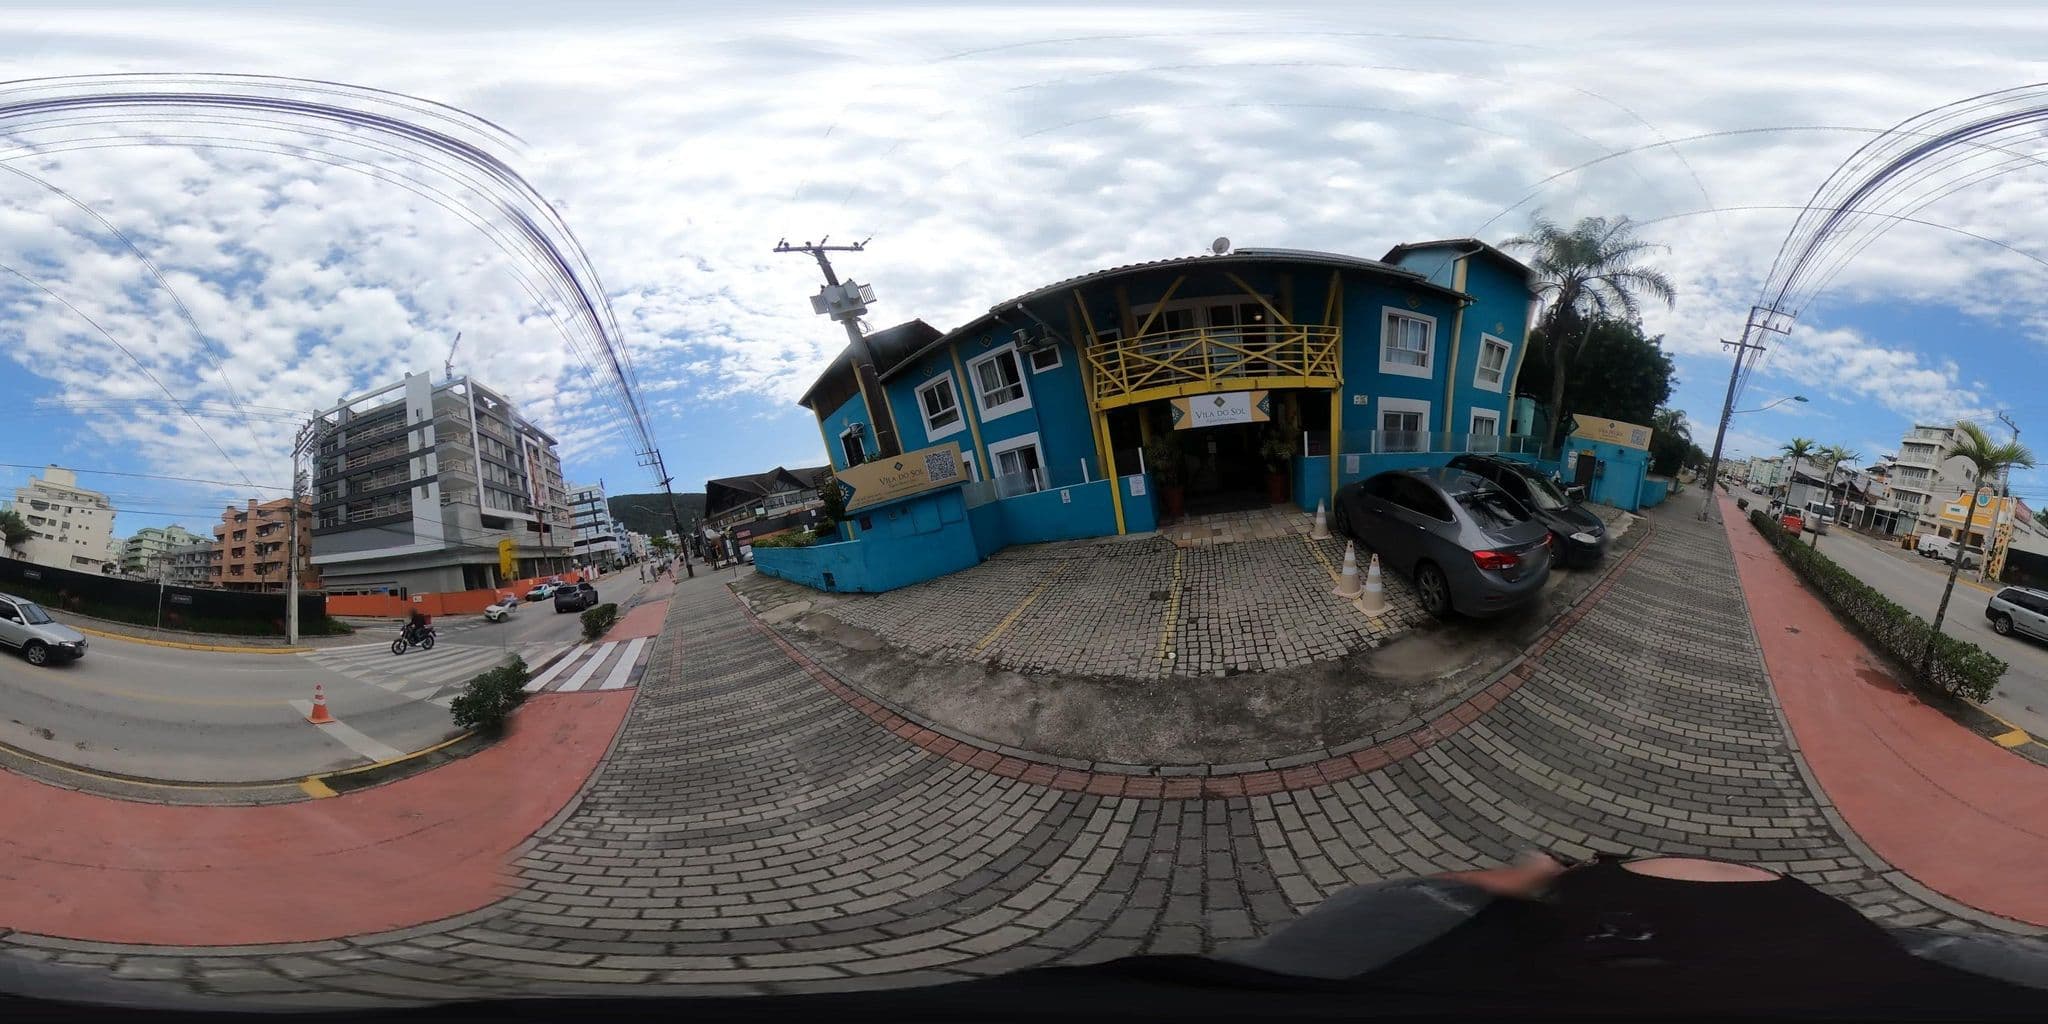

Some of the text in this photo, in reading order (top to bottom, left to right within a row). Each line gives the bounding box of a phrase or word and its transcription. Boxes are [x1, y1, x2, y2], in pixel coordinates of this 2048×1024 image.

[1195, 407, 1246, 419] VILA DO SOL
[879, 476, 896, 486] VILA
[898, 472, 910, 480] DO
[910, 468, 924, 478] SOL
